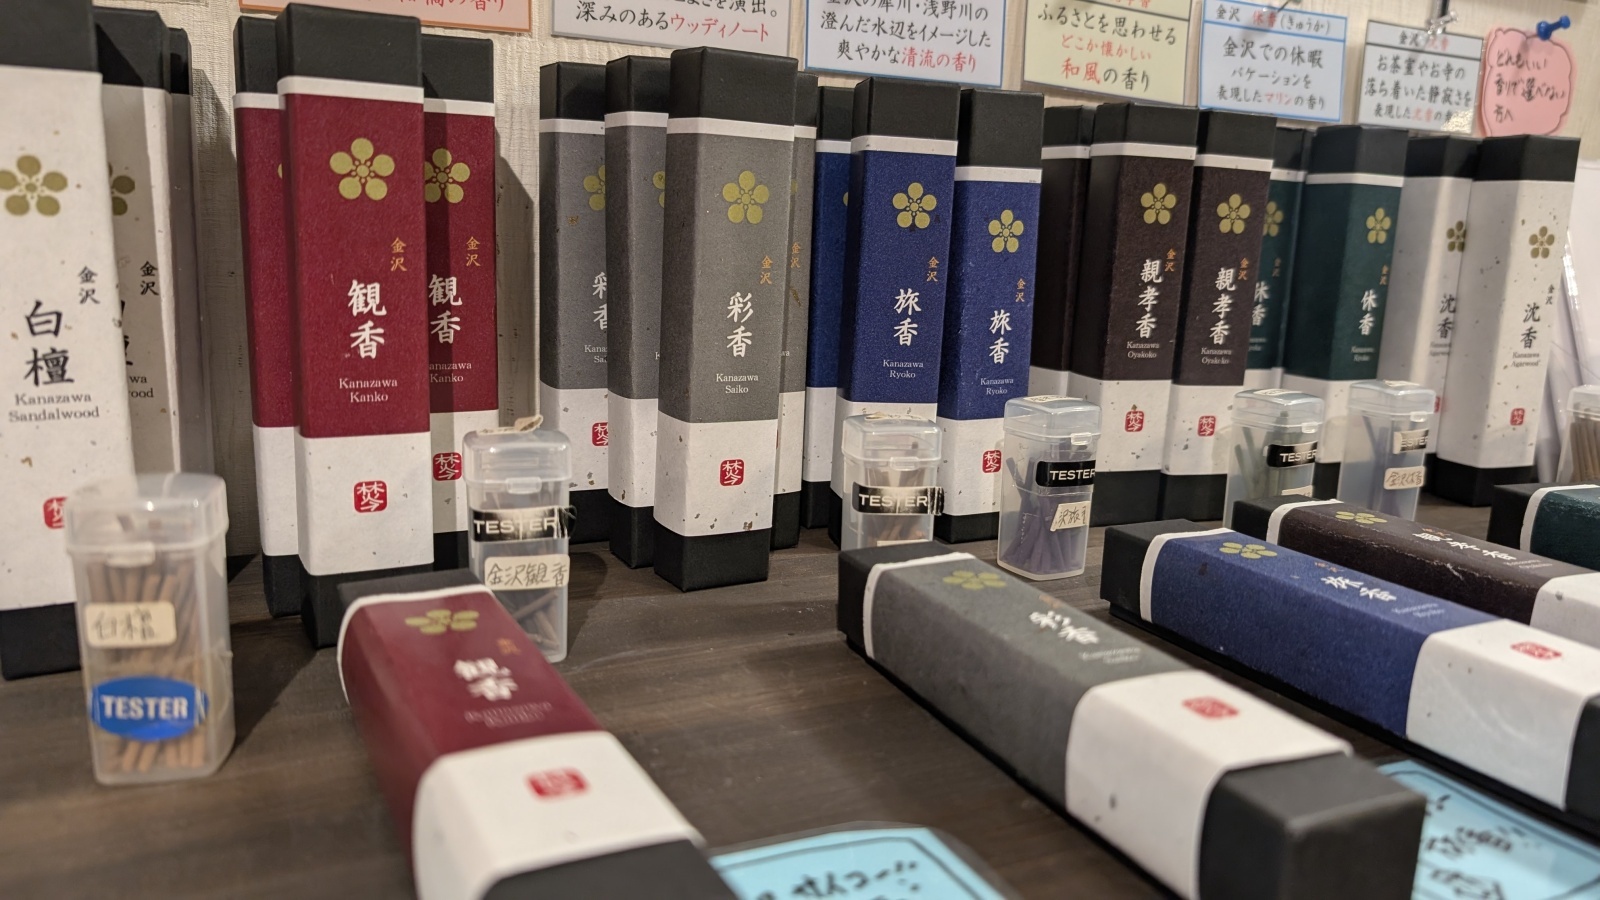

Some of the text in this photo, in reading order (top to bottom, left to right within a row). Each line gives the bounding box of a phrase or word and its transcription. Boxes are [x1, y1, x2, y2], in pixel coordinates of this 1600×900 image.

[575, 0, 769, 43] 深みのあるウッディノート
[820, 10, 991, 48] 澄んだ水辺をイメージした
[1038, 4, 1176, 46] ふるさとを思わせる
[837, 39, 977, 73] 爽やかな清流の香り
[1061, 34, 1152, 61] どこか懐かしい
[1222, 35, 1323, 69] 金沢での休暇
[1061, 57, 1151, 92] 和風の香り
[1230, 66, 1312, 89] バケーションを
[390, 237, 407, 272] 金沢
[466, 236, 481, 267] 金沢
[790, 242, 801, 269] 金沢
[1164, 248, 1176, 272] 金沢
[140, 261, 159, 296] 金沢
[760, 255, 773, 285] 金沢
[926, 256, 940, 282] 金沢
[1238, 257, 1249, 281] 金沢
[78, 266, 100, 304] 金沢
[1015, 278, 1027, 303] 金沢
[1135, 258, 1163, 339] 親孝香
[347, 279, 387, 359] 観香
[428, 274, 463, 344] 観香
[893, 288, 922, 346] 旅香
[1209, 267, 1238, 345] 親孝香
[1358, 288, 1379, 336] 休香
[726, 291, 754, 358] 彩香
[988, 309, 1013, 364] 旅香
[1520, 302, 1540, 349] 沈香
[24, 300, 74, 387] 白檀
[1126, 341, 1160, 350] Kanazawa
[429, 362, 472, 370] anazawa
[883, 359, 924, 368] Kanazawa
[889, 370, 916, 379] Ryoko
[339, 378, 398, 389] Kanazawa
[716, 373, 759, 383] Kanazawa
[725, 385, 749, 394] Saiko
[980, 377, 1014, 386] Kanazawa
[985, 387, 1008, 396] Ryoko
[15, 392, 92, 406] Kanazawa
[350, 391, 389, 403] Kanko
[8, 406, 100, 423] Sandalwood
[859, 491, 928, 508] TESTER
[473, 516, 558, 536] TESTER
[100, 694, 189, 720] TESTER
